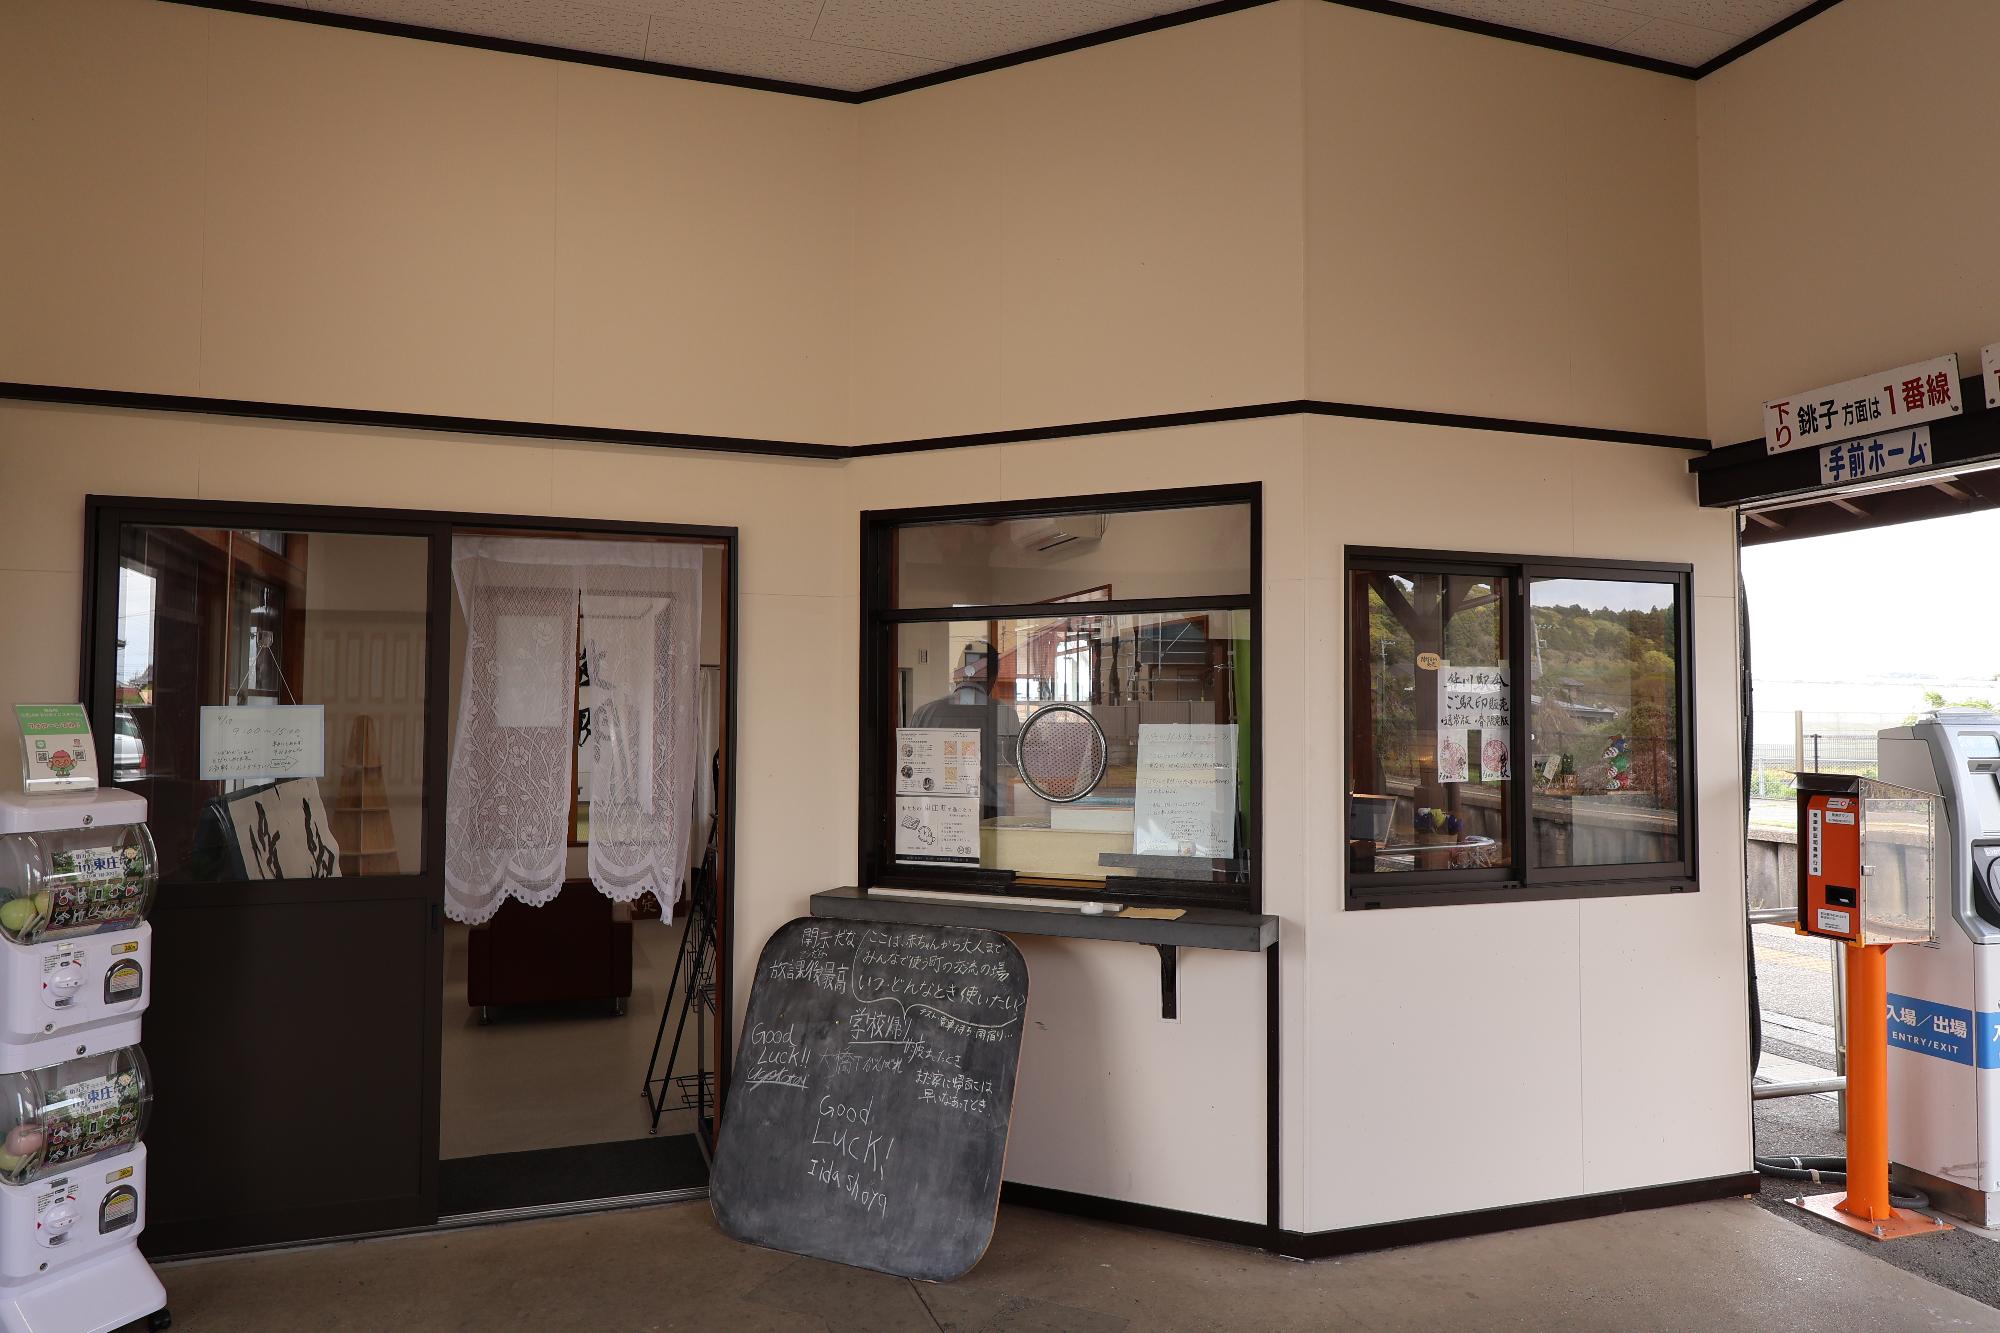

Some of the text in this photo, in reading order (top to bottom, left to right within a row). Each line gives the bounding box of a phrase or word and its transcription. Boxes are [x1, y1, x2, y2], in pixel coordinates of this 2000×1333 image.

[1828, 431, 1927, 482] 手前ホーム
[93, 855, 121, 871] 東庄
[769, 959, 849, 995] 放課後最高
[751, 1022, 796, 1047] Good
[1892, 1031, 1959, 1054] ENTRY/EXIT
[87, 1085, 115, 1104] 東庄
[819, 1094, 874, 1126] Good
